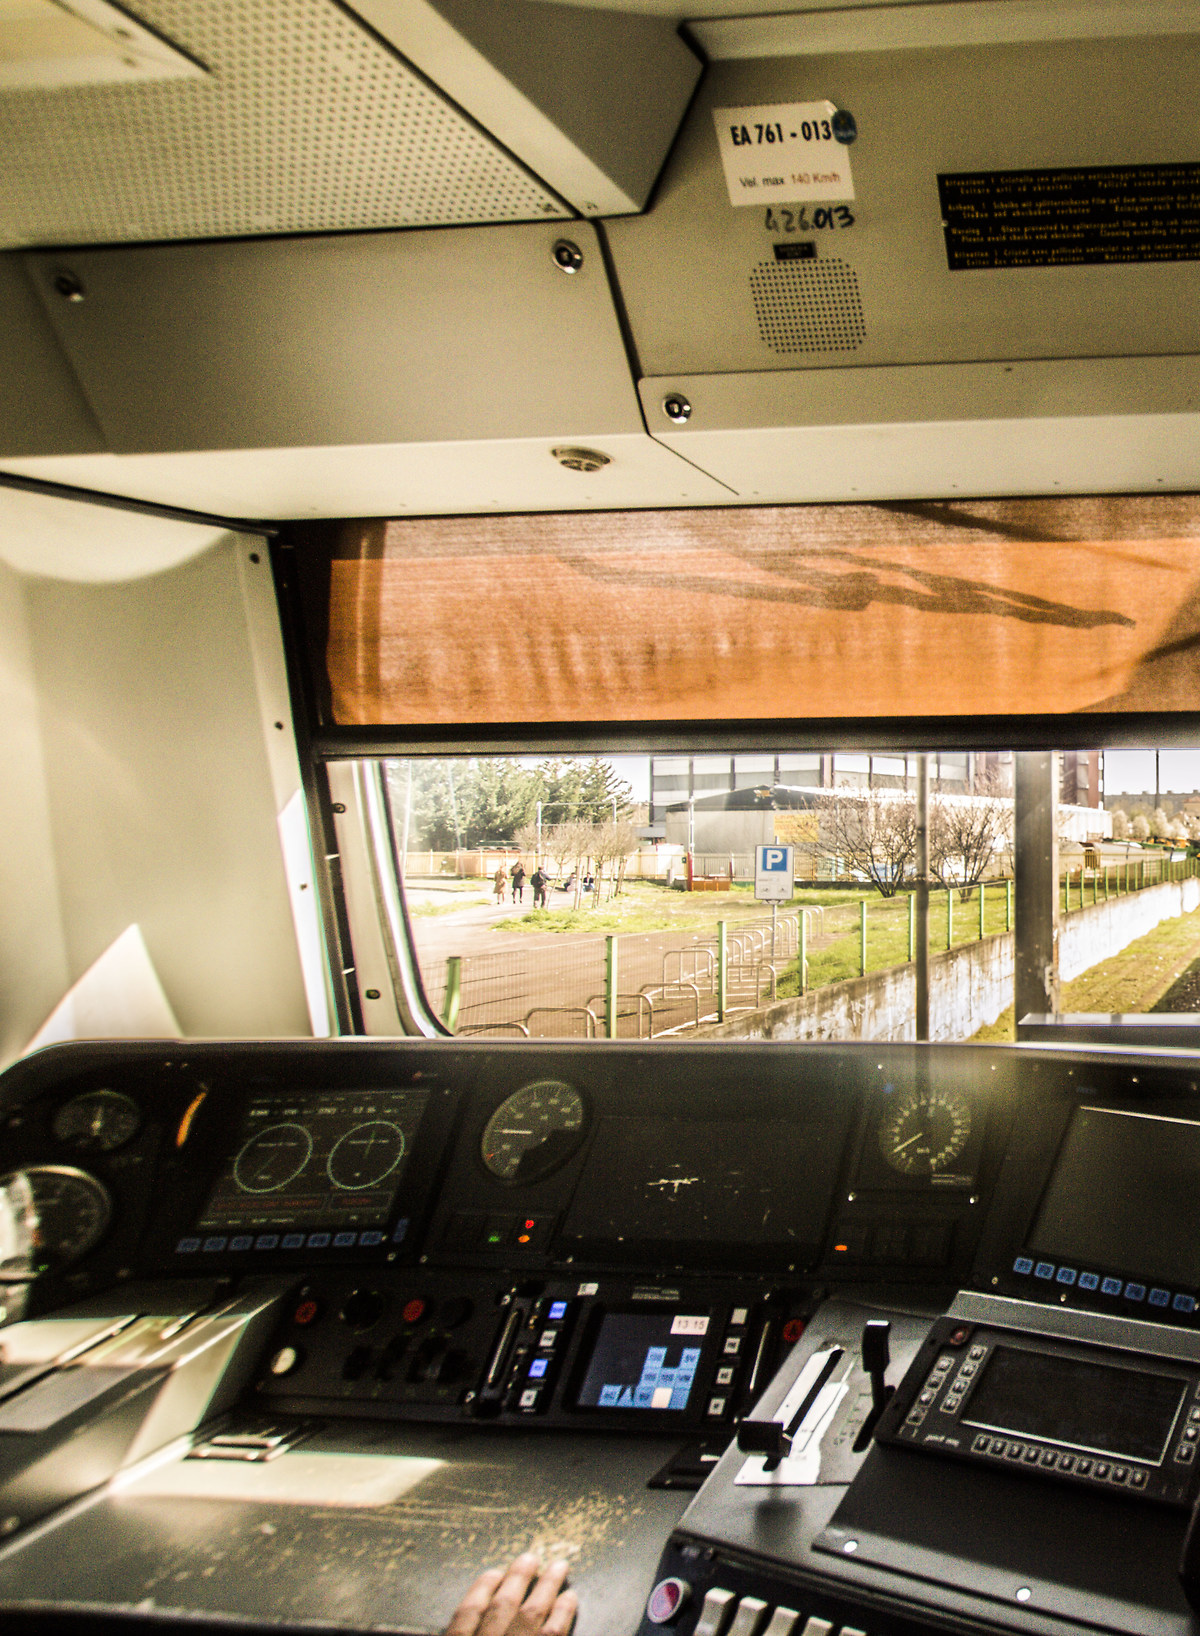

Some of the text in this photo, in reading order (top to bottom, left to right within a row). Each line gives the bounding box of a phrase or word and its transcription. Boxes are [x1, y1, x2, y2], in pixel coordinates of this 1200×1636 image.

[730, 124, 752, 146] EA
[755, 122, 783, 144] 761
[801, 120, 832, 142] 013
[762, 176, 785, 186] max
[791, 173, 810, 185] 140
[766, 850, 783, 869] P
